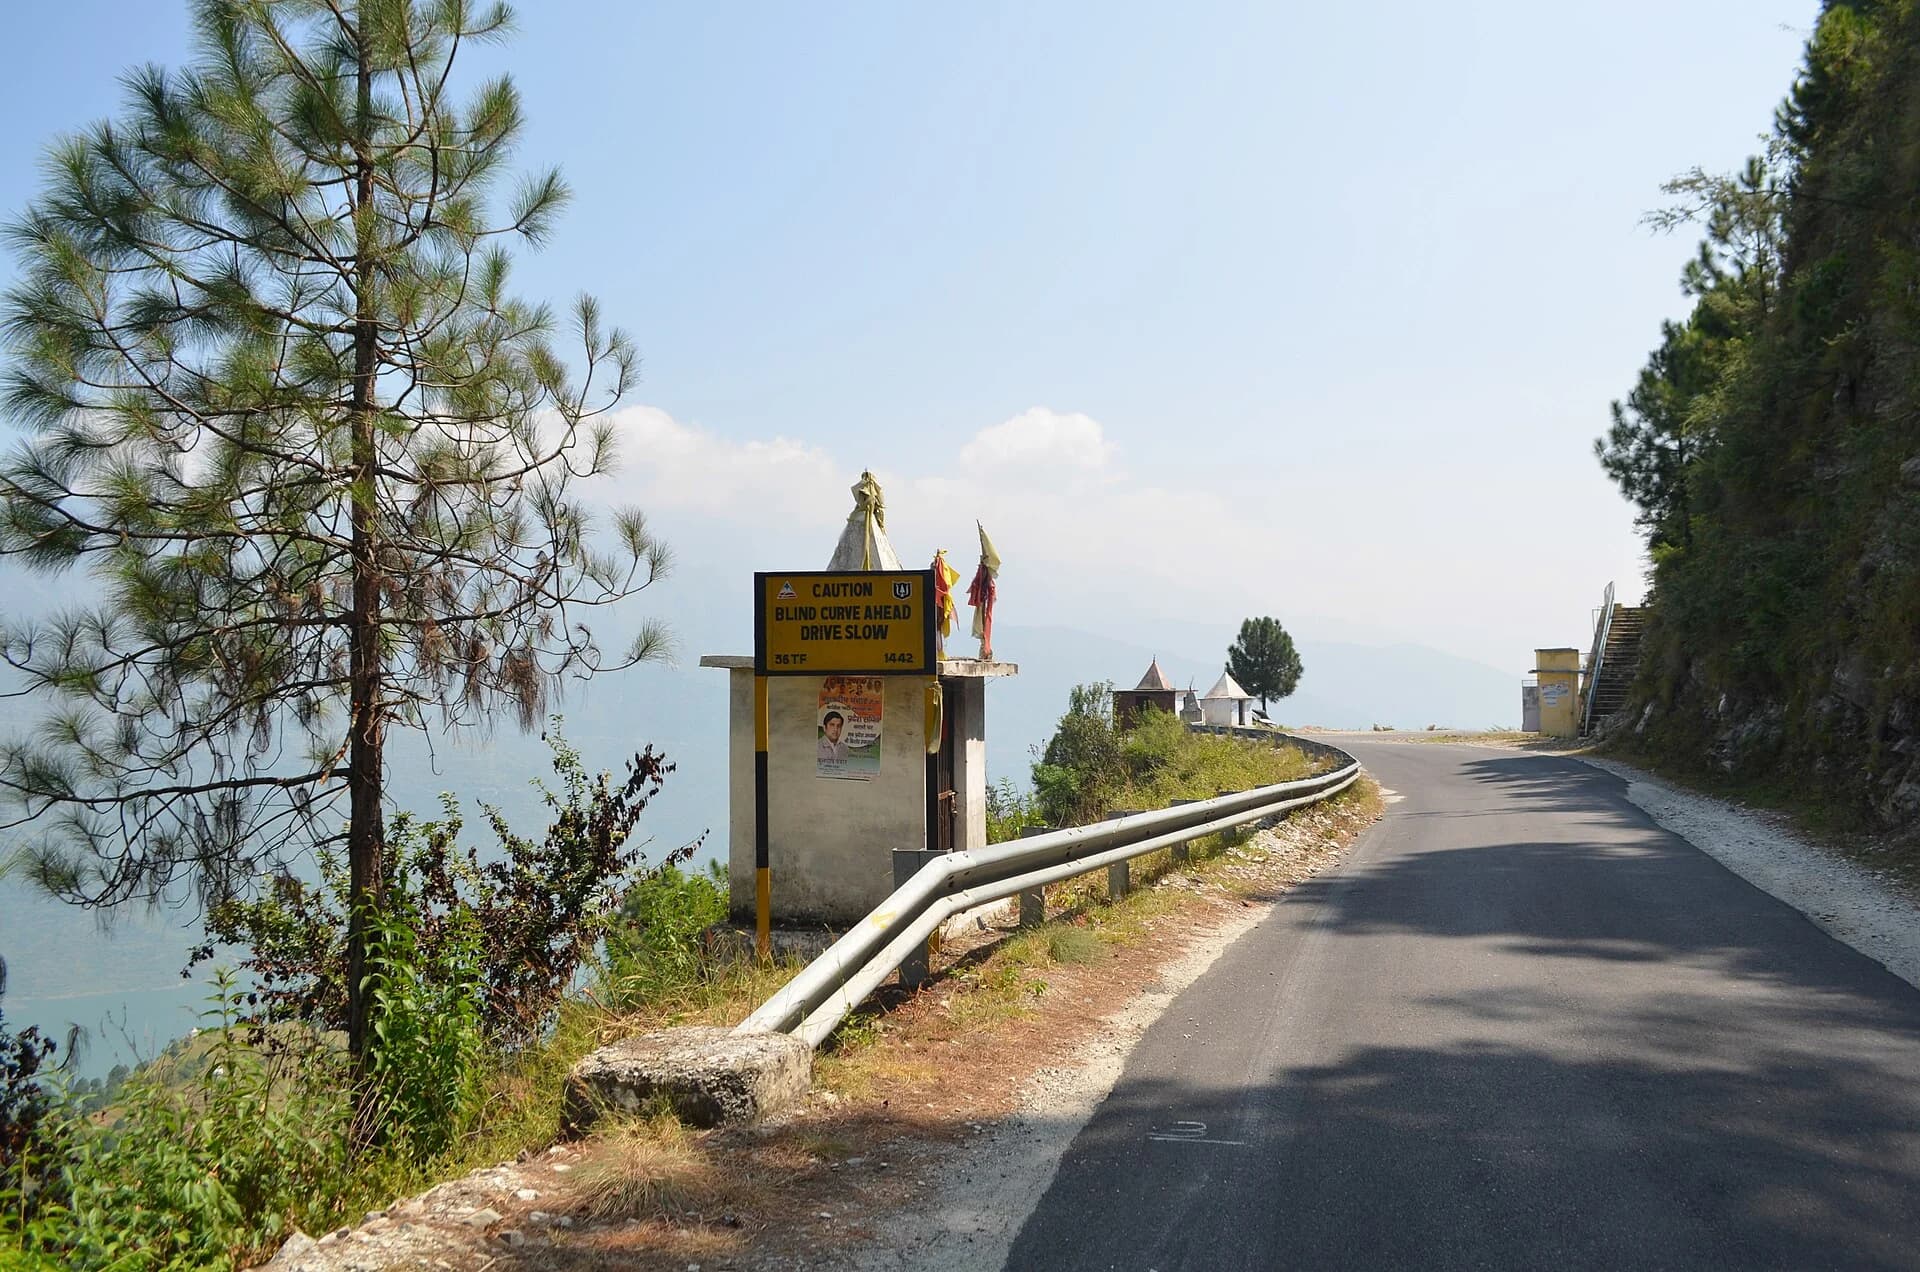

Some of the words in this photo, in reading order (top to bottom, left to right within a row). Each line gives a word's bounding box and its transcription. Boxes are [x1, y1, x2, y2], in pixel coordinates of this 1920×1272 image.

[812, 583, 872, 598] CAUTION
[775, 607, 816, 621] BLIND
[821, 605, 860, 620] CURVE
[864, 605, 911, 620] AHEAD
[801, 625, 841, 640] DRIVE
[845, 624, 888, 640] SLOW
[884, 653, 914, 664] 1442
